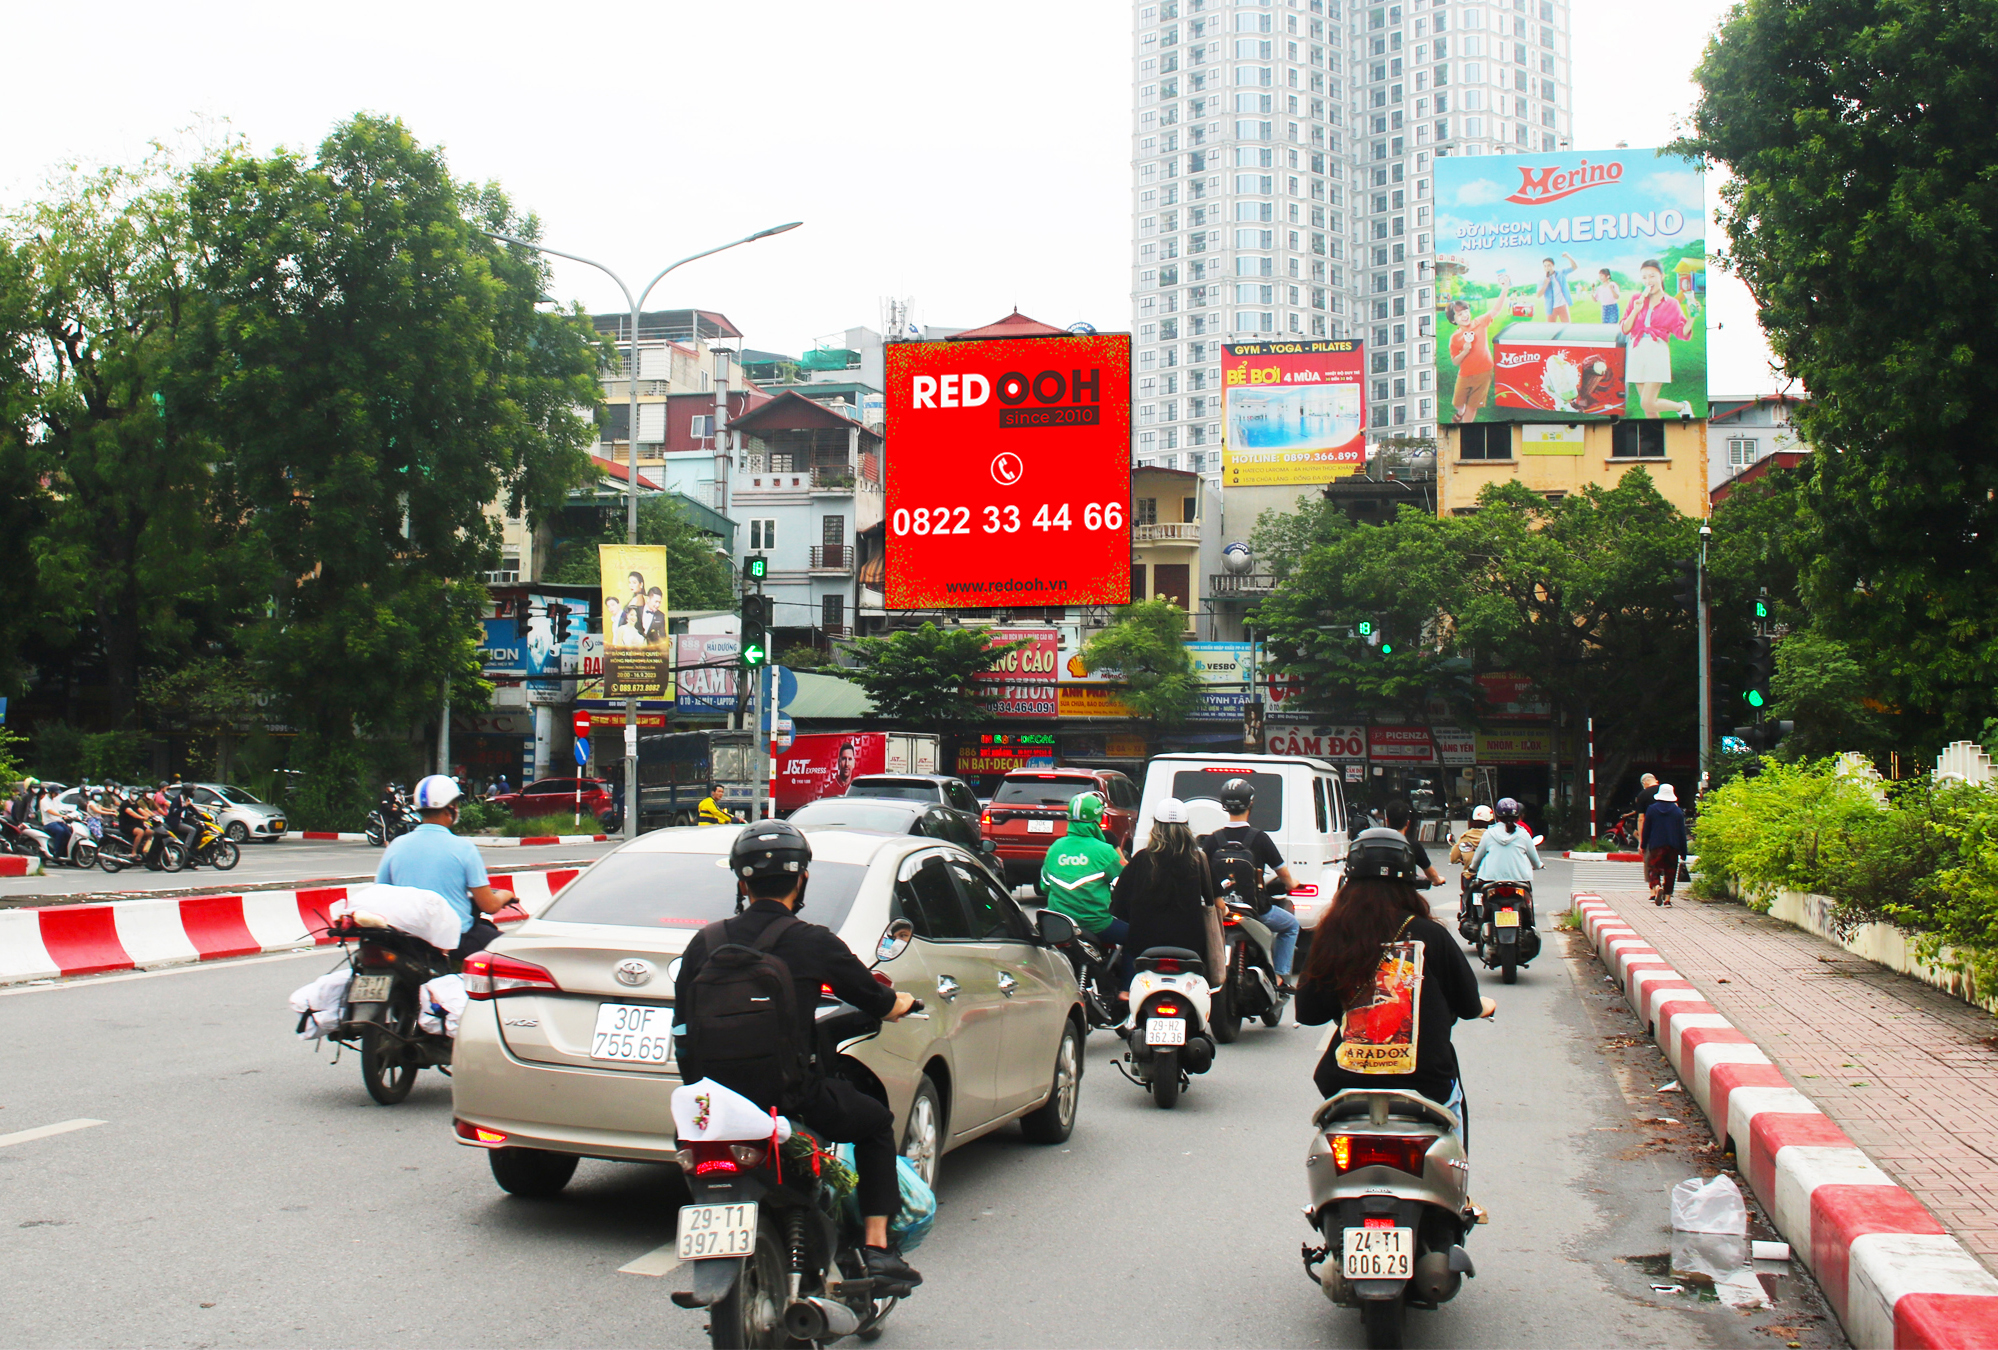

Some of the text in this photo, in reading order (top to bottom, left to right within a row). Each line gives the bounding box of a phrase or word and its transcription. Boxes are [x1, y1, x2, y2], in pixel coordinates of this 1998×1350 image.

[1516, 159, 1623, 199] Merino
[1489, 221, 1532, 237] NGON
[1538, 209, 1684, 245] MERINO
[1461, 234, 1532, 251] NHƯ KEM
[1234, 341, 1353, 355] GYM YOGA PILATES
[1500, 351, 1541, 366] Merino
[1227, 360, 1321, 385] BỂ BƠI 4 MÙA
[913, 369, 1100, 409] RED OOH
[1005, 409, 1093, 425] since 2010
[1232, 452, 1358, 464] HOTLINE: 0899.366.899
[893, 502, 1123, 536] 0822 33 44 66
[752, 561, 763, 577] 18
[946, 578, 1068, 593] www.redooh.vn
[1359, 621, 1371, 635] 18
[707, 641, 717, 651] HẢI
[718, 642, 737, 651] DƯƠNG
[1022, 643, 1054, 672] CÁO
[680, 651, 727, 694] CẦM
[717, 698, 735, 706] LAPTOP
[1202, 694, 1229, 704] UỲNH
[986, 702, 1055, 713] 0934.464.091
[981, 734, 993, 743] IN
[1268, 726, 1363, 756] CẦM ĐỒ
[1385, 731, 1429, 740] PICENZA
[959, 748, 977, 756] 886
[782, 759, 811, 774] J&T
[958, 758, 969, 770] IN
[1058, 853, 1089, 866] Grab
[504, 1017, 539, 1027] VIOS
[614, 1007, 655, 1032] 30F
[1149, 1032, 1182, 1043] 362.36
[594, 1033, 666, 1060] 755.65
[690, 1206, 745, 1231] 29-T1
[683, 1229, 749, 1256] 397.13
[1355, 1232, 1400, 1252] 24-T1
[1349, 1255, 1408, 1275] 006.29
